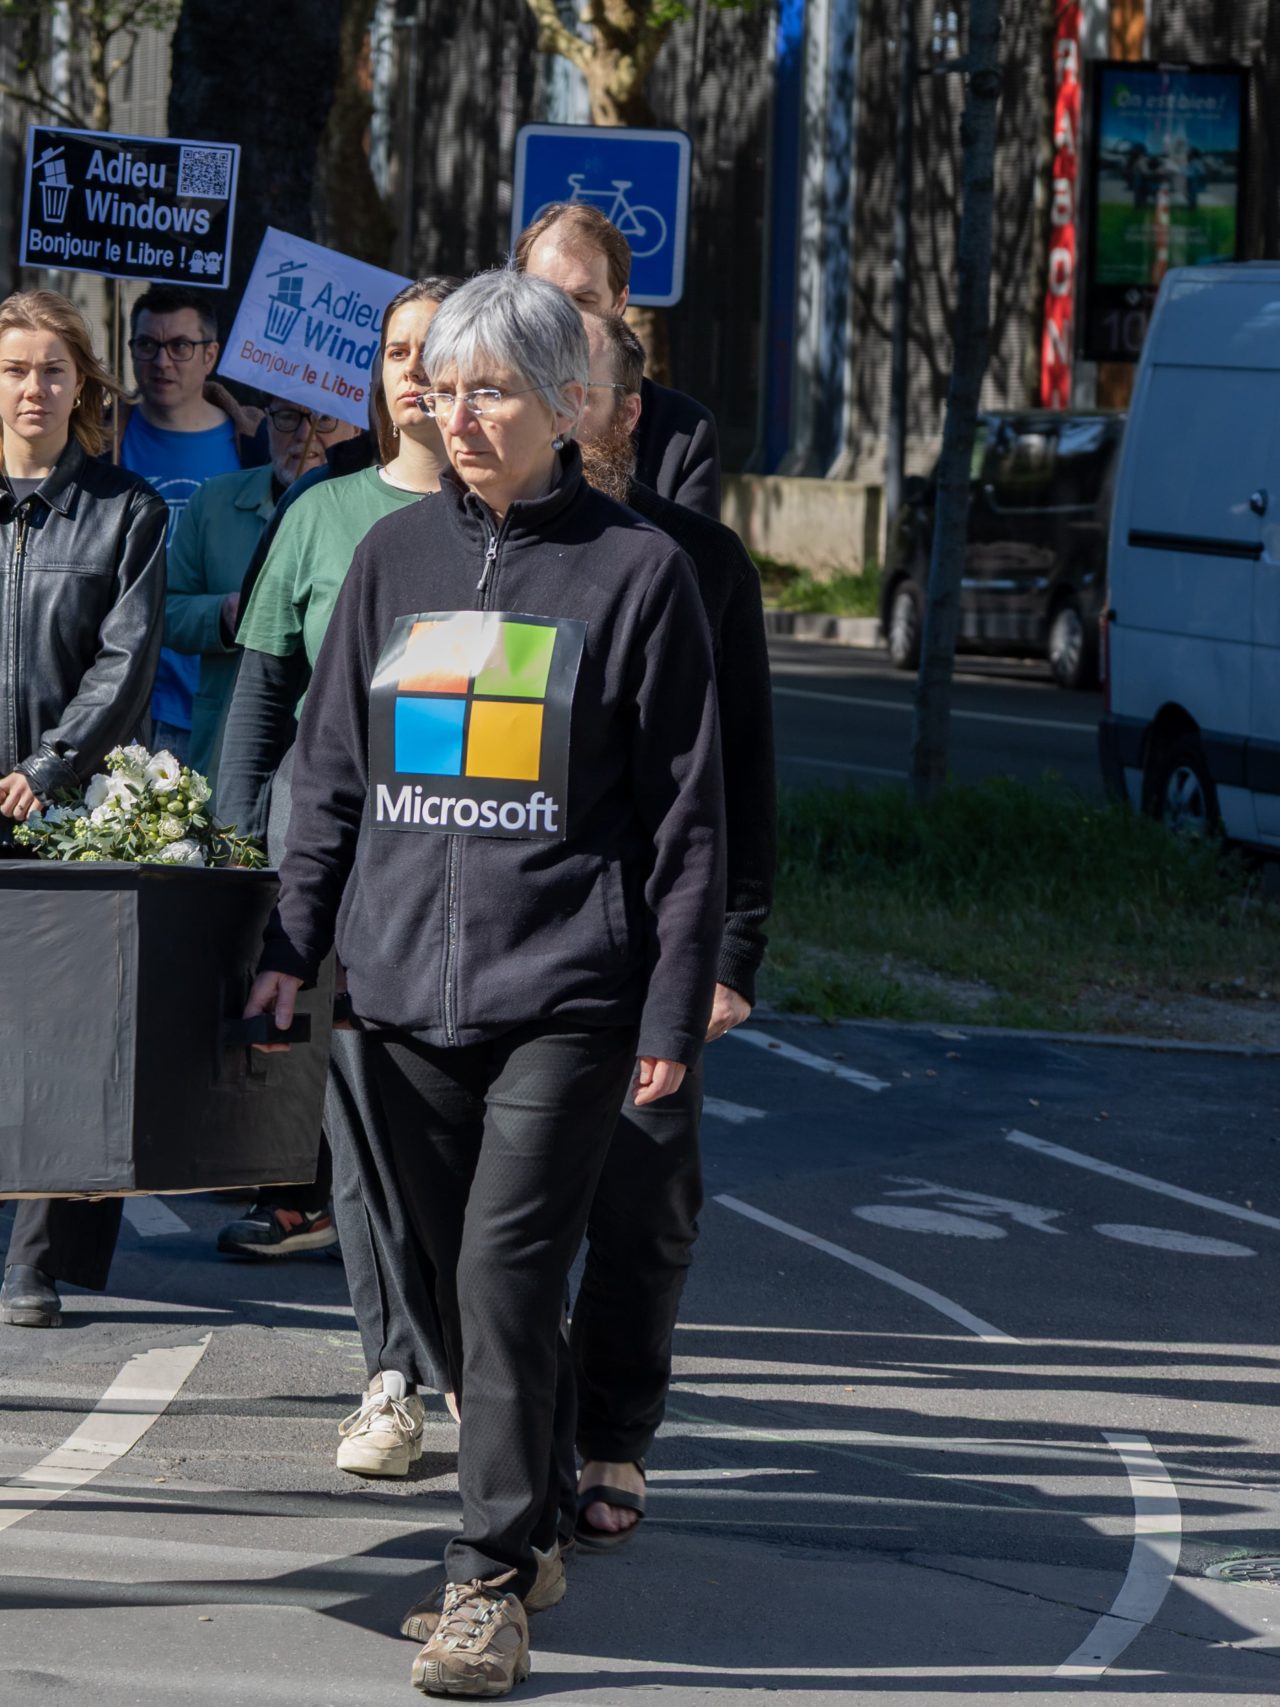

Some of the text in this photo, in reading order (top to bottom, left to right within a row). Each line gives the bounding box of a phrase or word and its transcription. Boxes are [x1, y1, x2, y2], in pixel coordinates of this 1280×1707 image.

[85, 149, 167, 189] Adieu
[85, 188, 211, 235] Windows
[1046, 37, 1078, 409] RABON
[28, 228, 102, 260] Bonjour
[106, 238, 121, 263] le
[126, 240, 175, 268] Libre
[311, 281, 383, 334] Adieu
[303, 315, 379, 371] Wind
[240, 340, 365, 403] Bonjour le Libre
[375, 783, 559, 833] Microsoft
